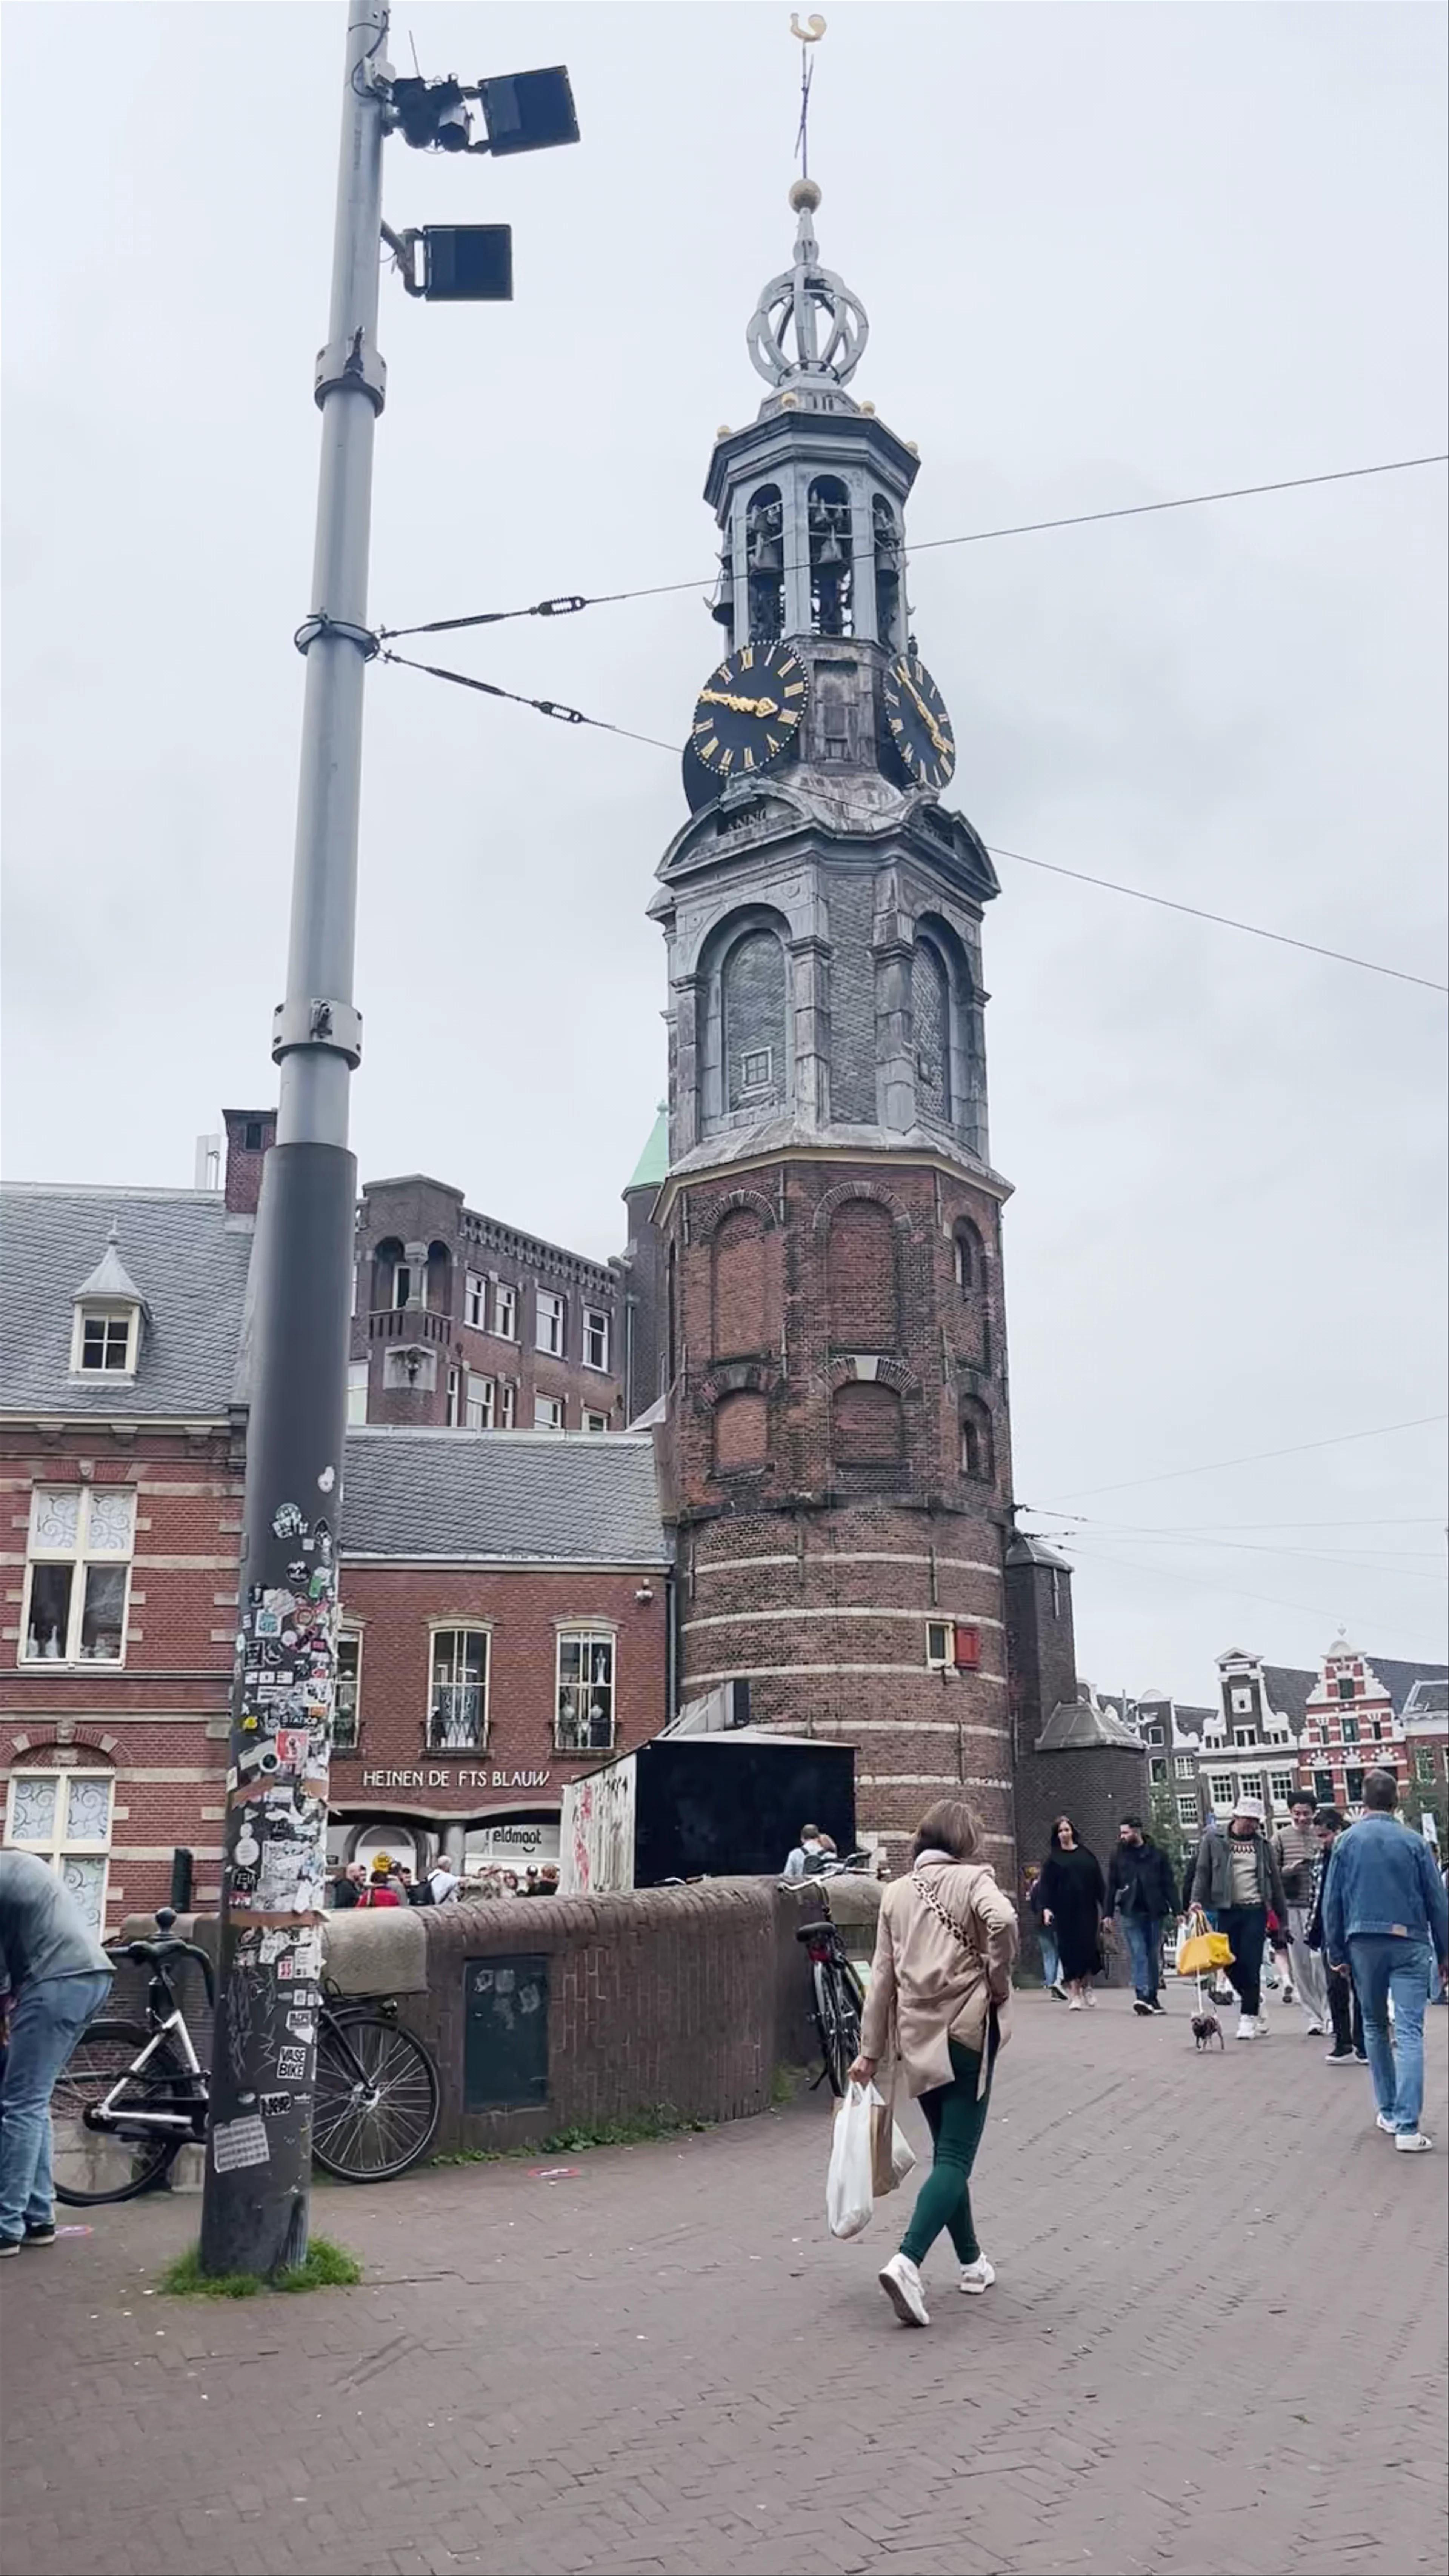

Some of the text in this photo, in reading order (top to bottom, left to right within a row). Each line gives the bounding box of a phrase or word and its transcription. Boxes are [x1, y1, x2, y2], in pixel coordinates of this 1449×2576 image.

[363, 1770, 423, 1786] HEINEN
[492, 1770, 550, 1787] BLAUW
[281, 2048, 305, 2063] VASE
[278, 2063, 304, 2077] BIKE
